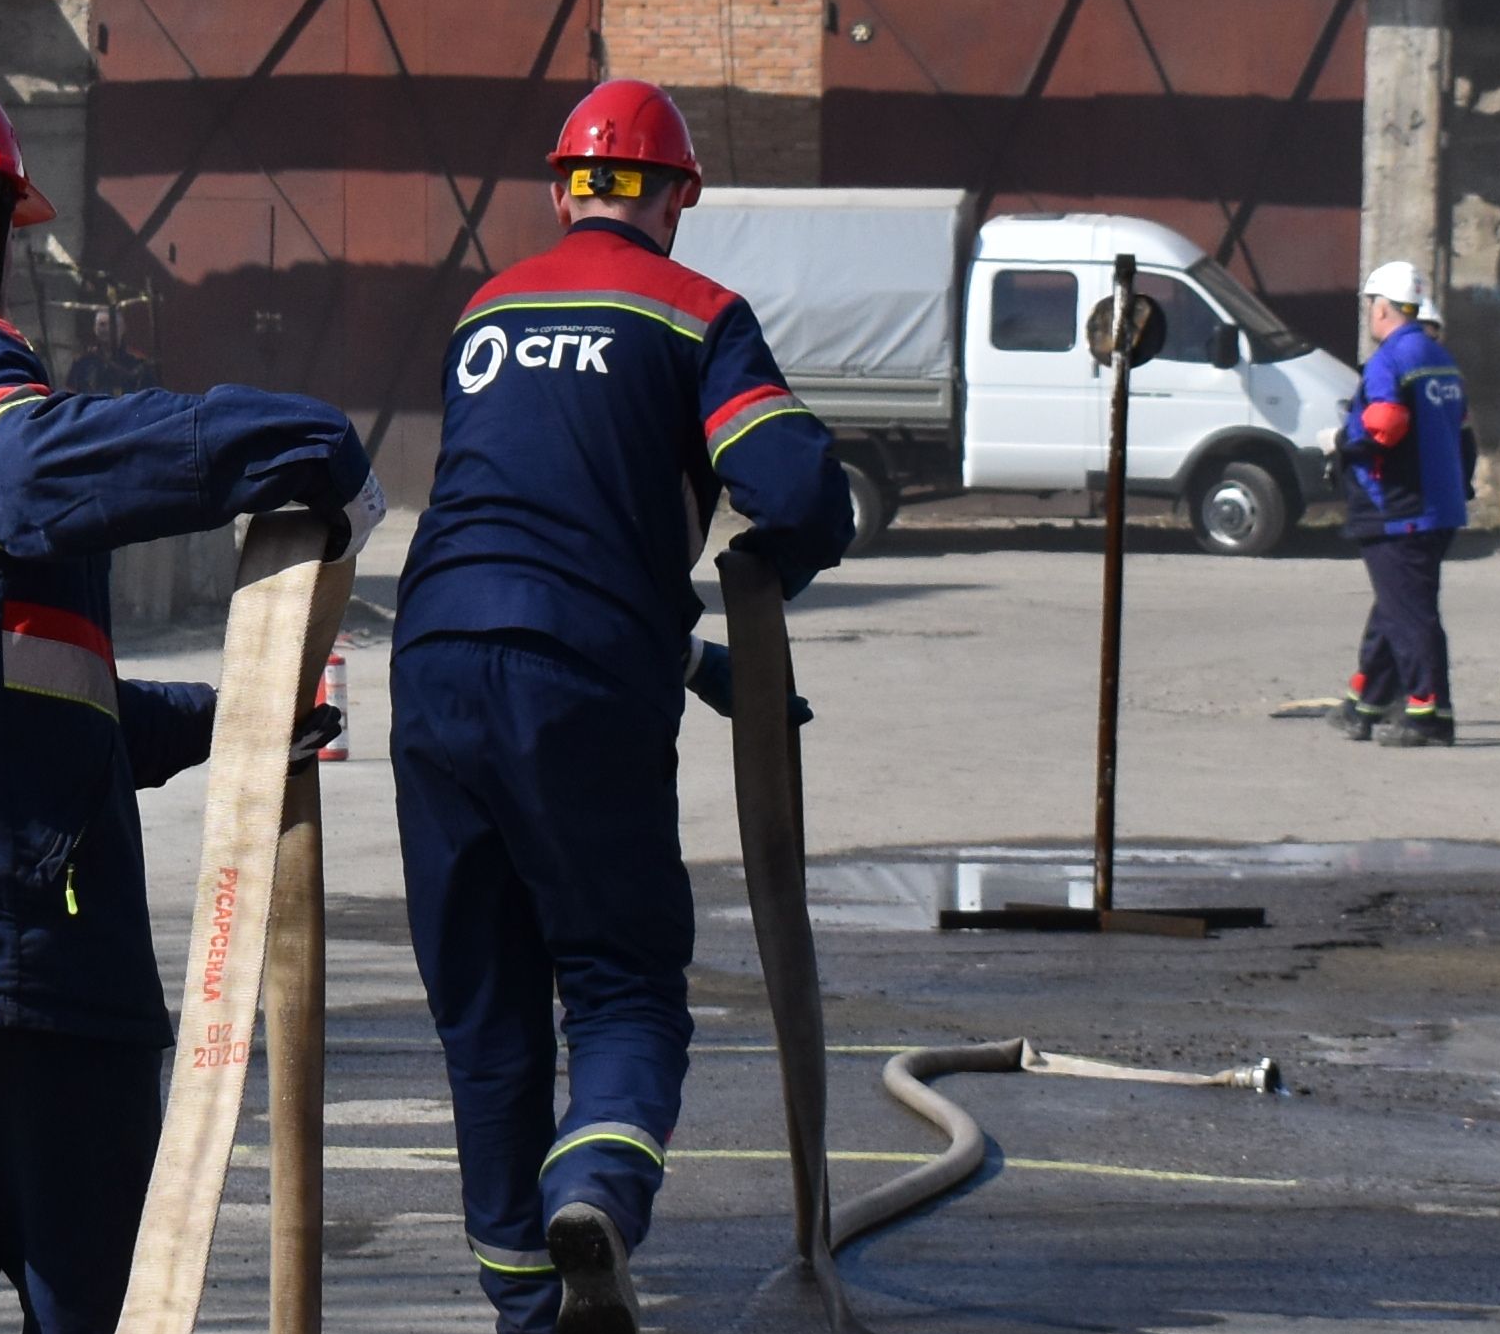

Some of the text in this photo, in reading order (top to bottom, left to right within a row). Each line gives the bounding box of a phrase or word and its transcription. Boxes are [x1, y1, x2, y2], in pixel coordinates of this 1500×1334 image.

[515, 335, 613, 374] СГК
[207, 1023, 232, 1044] 02
[194, 1041, 247, 1068] 2020
